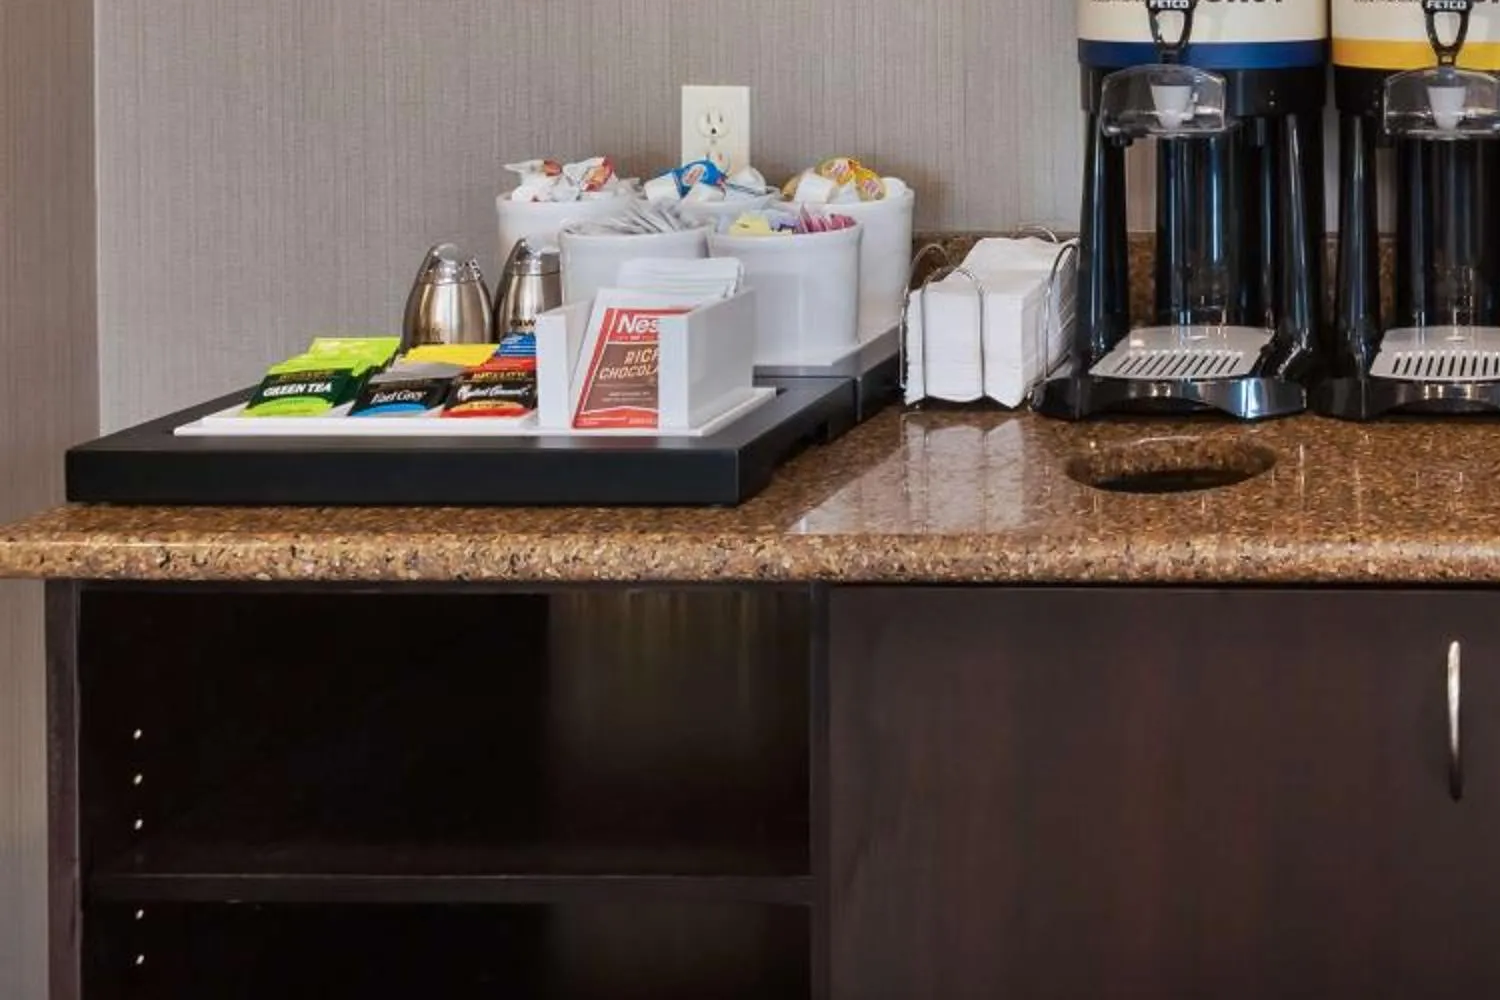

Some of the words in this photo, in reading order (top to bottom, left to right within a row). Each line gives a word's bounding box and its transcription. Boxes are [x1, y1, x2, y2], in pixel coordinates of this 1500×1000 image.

[1149, 0, 1190, 9] FETCO
[1427, 0, 1467, 10] FETCO
[262, 383, 306, 397] GREEN
[306, 382, 332, 393] TEA
